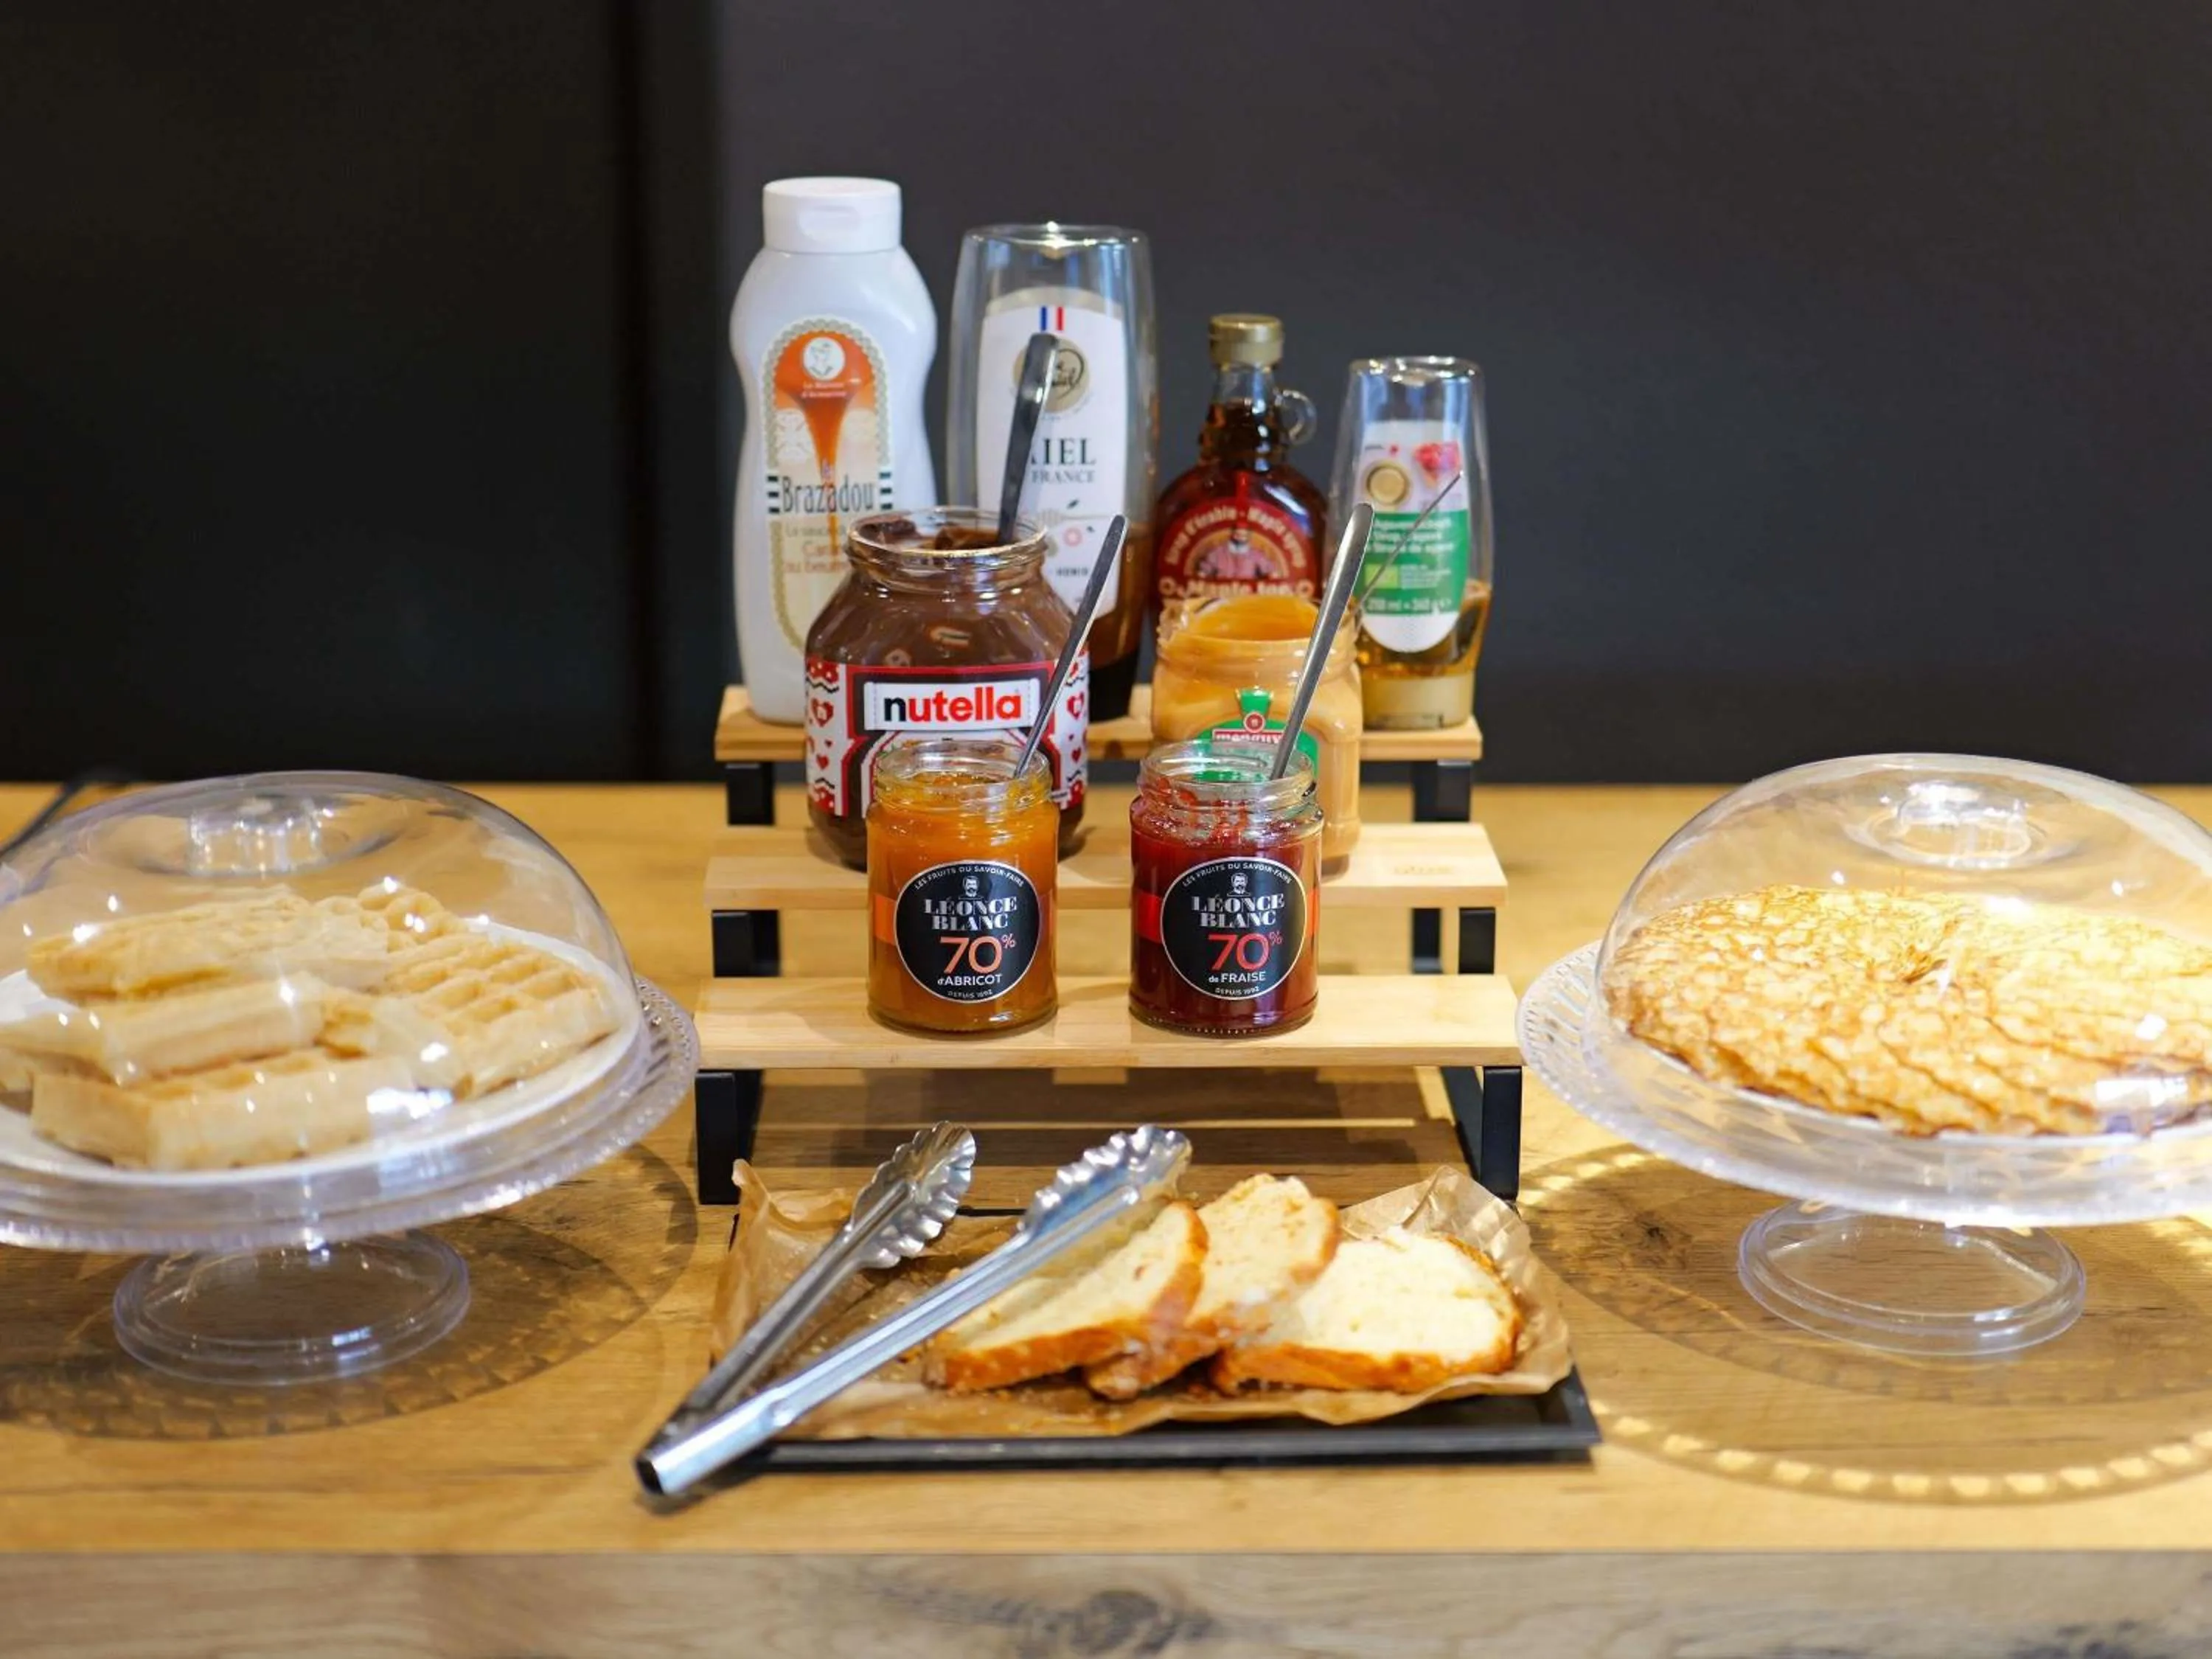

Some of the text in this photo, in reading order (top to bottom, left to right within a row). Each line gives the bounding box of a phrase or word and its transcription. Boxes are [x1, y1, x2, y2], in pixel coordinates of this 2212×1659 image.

[1031, 437, 1096, 465] IEL
[1032, 470, 1096, 484] FRANCE
[782, 473, 874, 513] Brazadou
[883, 686, 1022, 723] nutella
[928, 867, 957, 882] FRUITS
[1196, 864, 1225, 877] FRUITS
[924, 895, 1018, 917] LÉONCE
[1192, 893, 1285, 914] LÉONCE
[931, 914, 1009, 931] BLANC
[1200, 911, 1276, 929] BLANC
[940, 933, 1016, 974] 70%
[1208, 930, 1282, 972] 70%
[1208, 970, 1266, 984] de FRAISE
